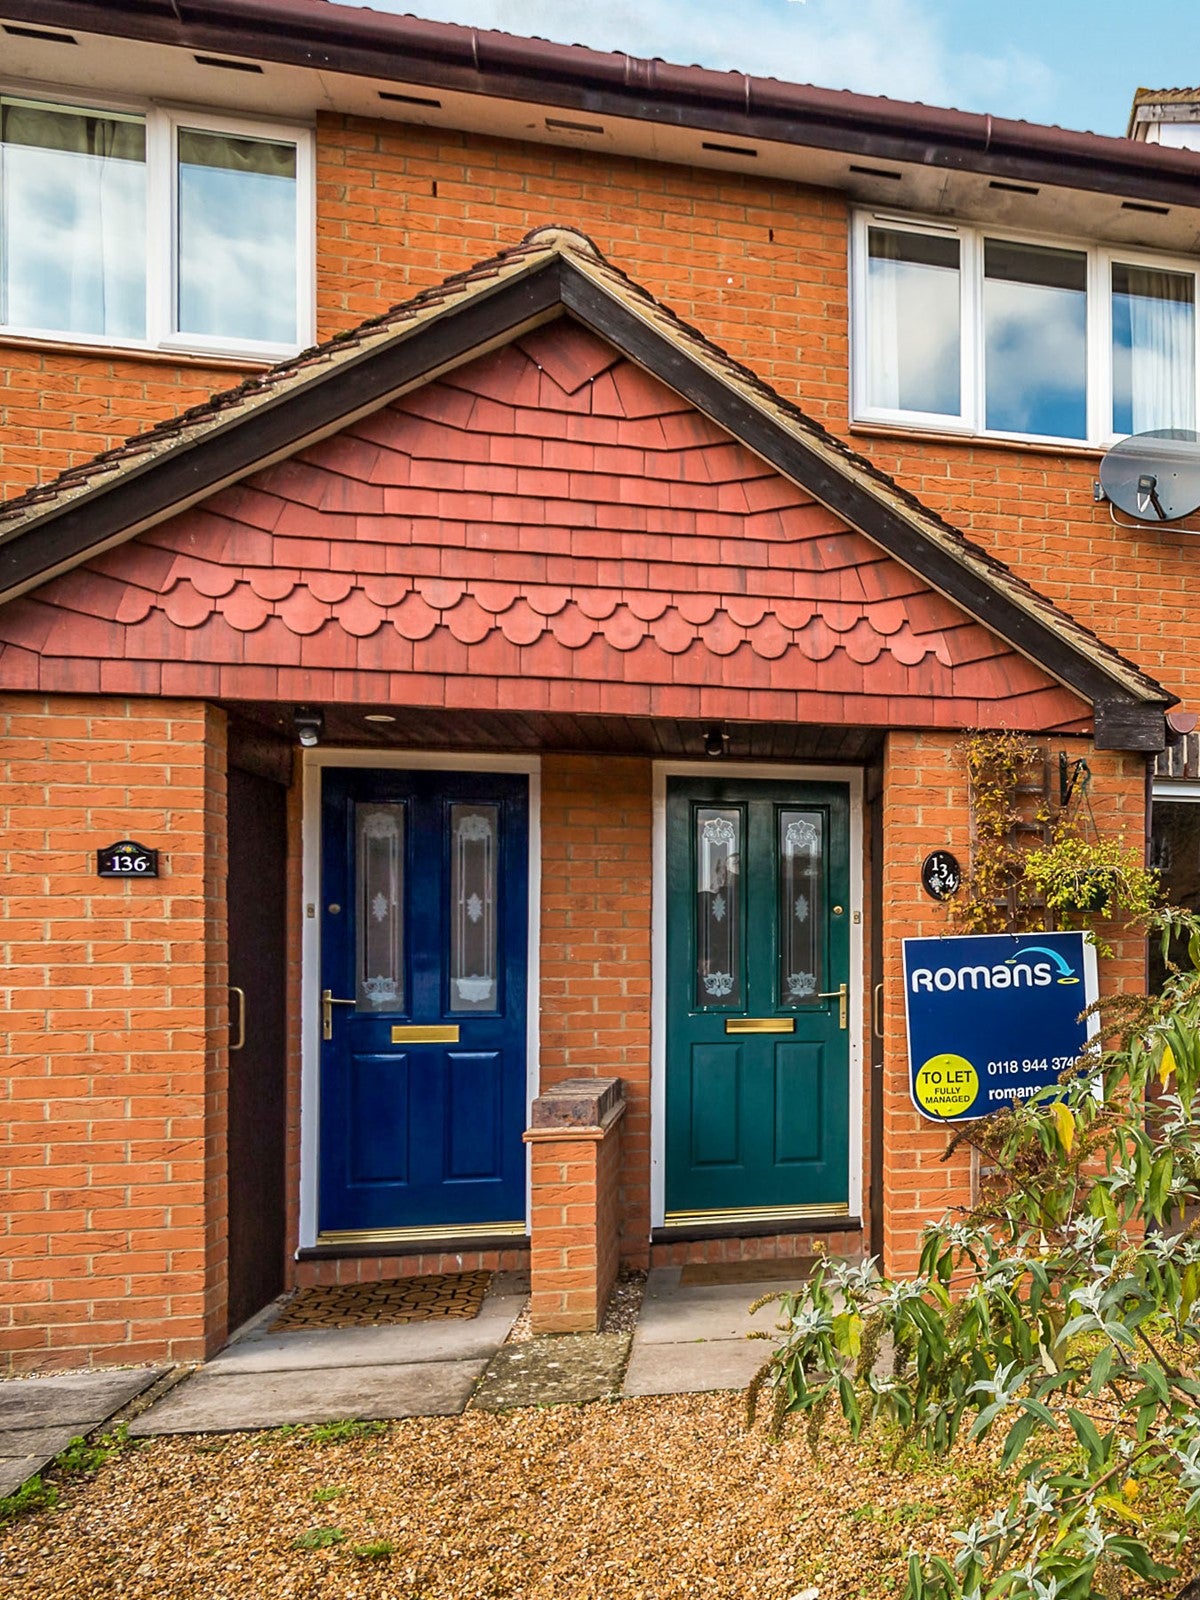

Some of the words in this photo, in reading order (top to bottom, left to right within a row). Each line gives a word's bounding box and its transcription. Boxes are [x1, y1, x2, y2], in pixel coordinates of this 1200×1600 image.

[112, 855, 147, 872] 136
[932, 857, 955, 888] 134
[987, 1060, 1018, 1076] 0118
[1022, 1058, 1048, 1073] 944
[922, 1071, 942, 1084] TO
[946, 1070, 972, 1083] LET
[934, 1087, 961, 1095] FULLY
[925, 1095, 970, 1104] MANAGED
